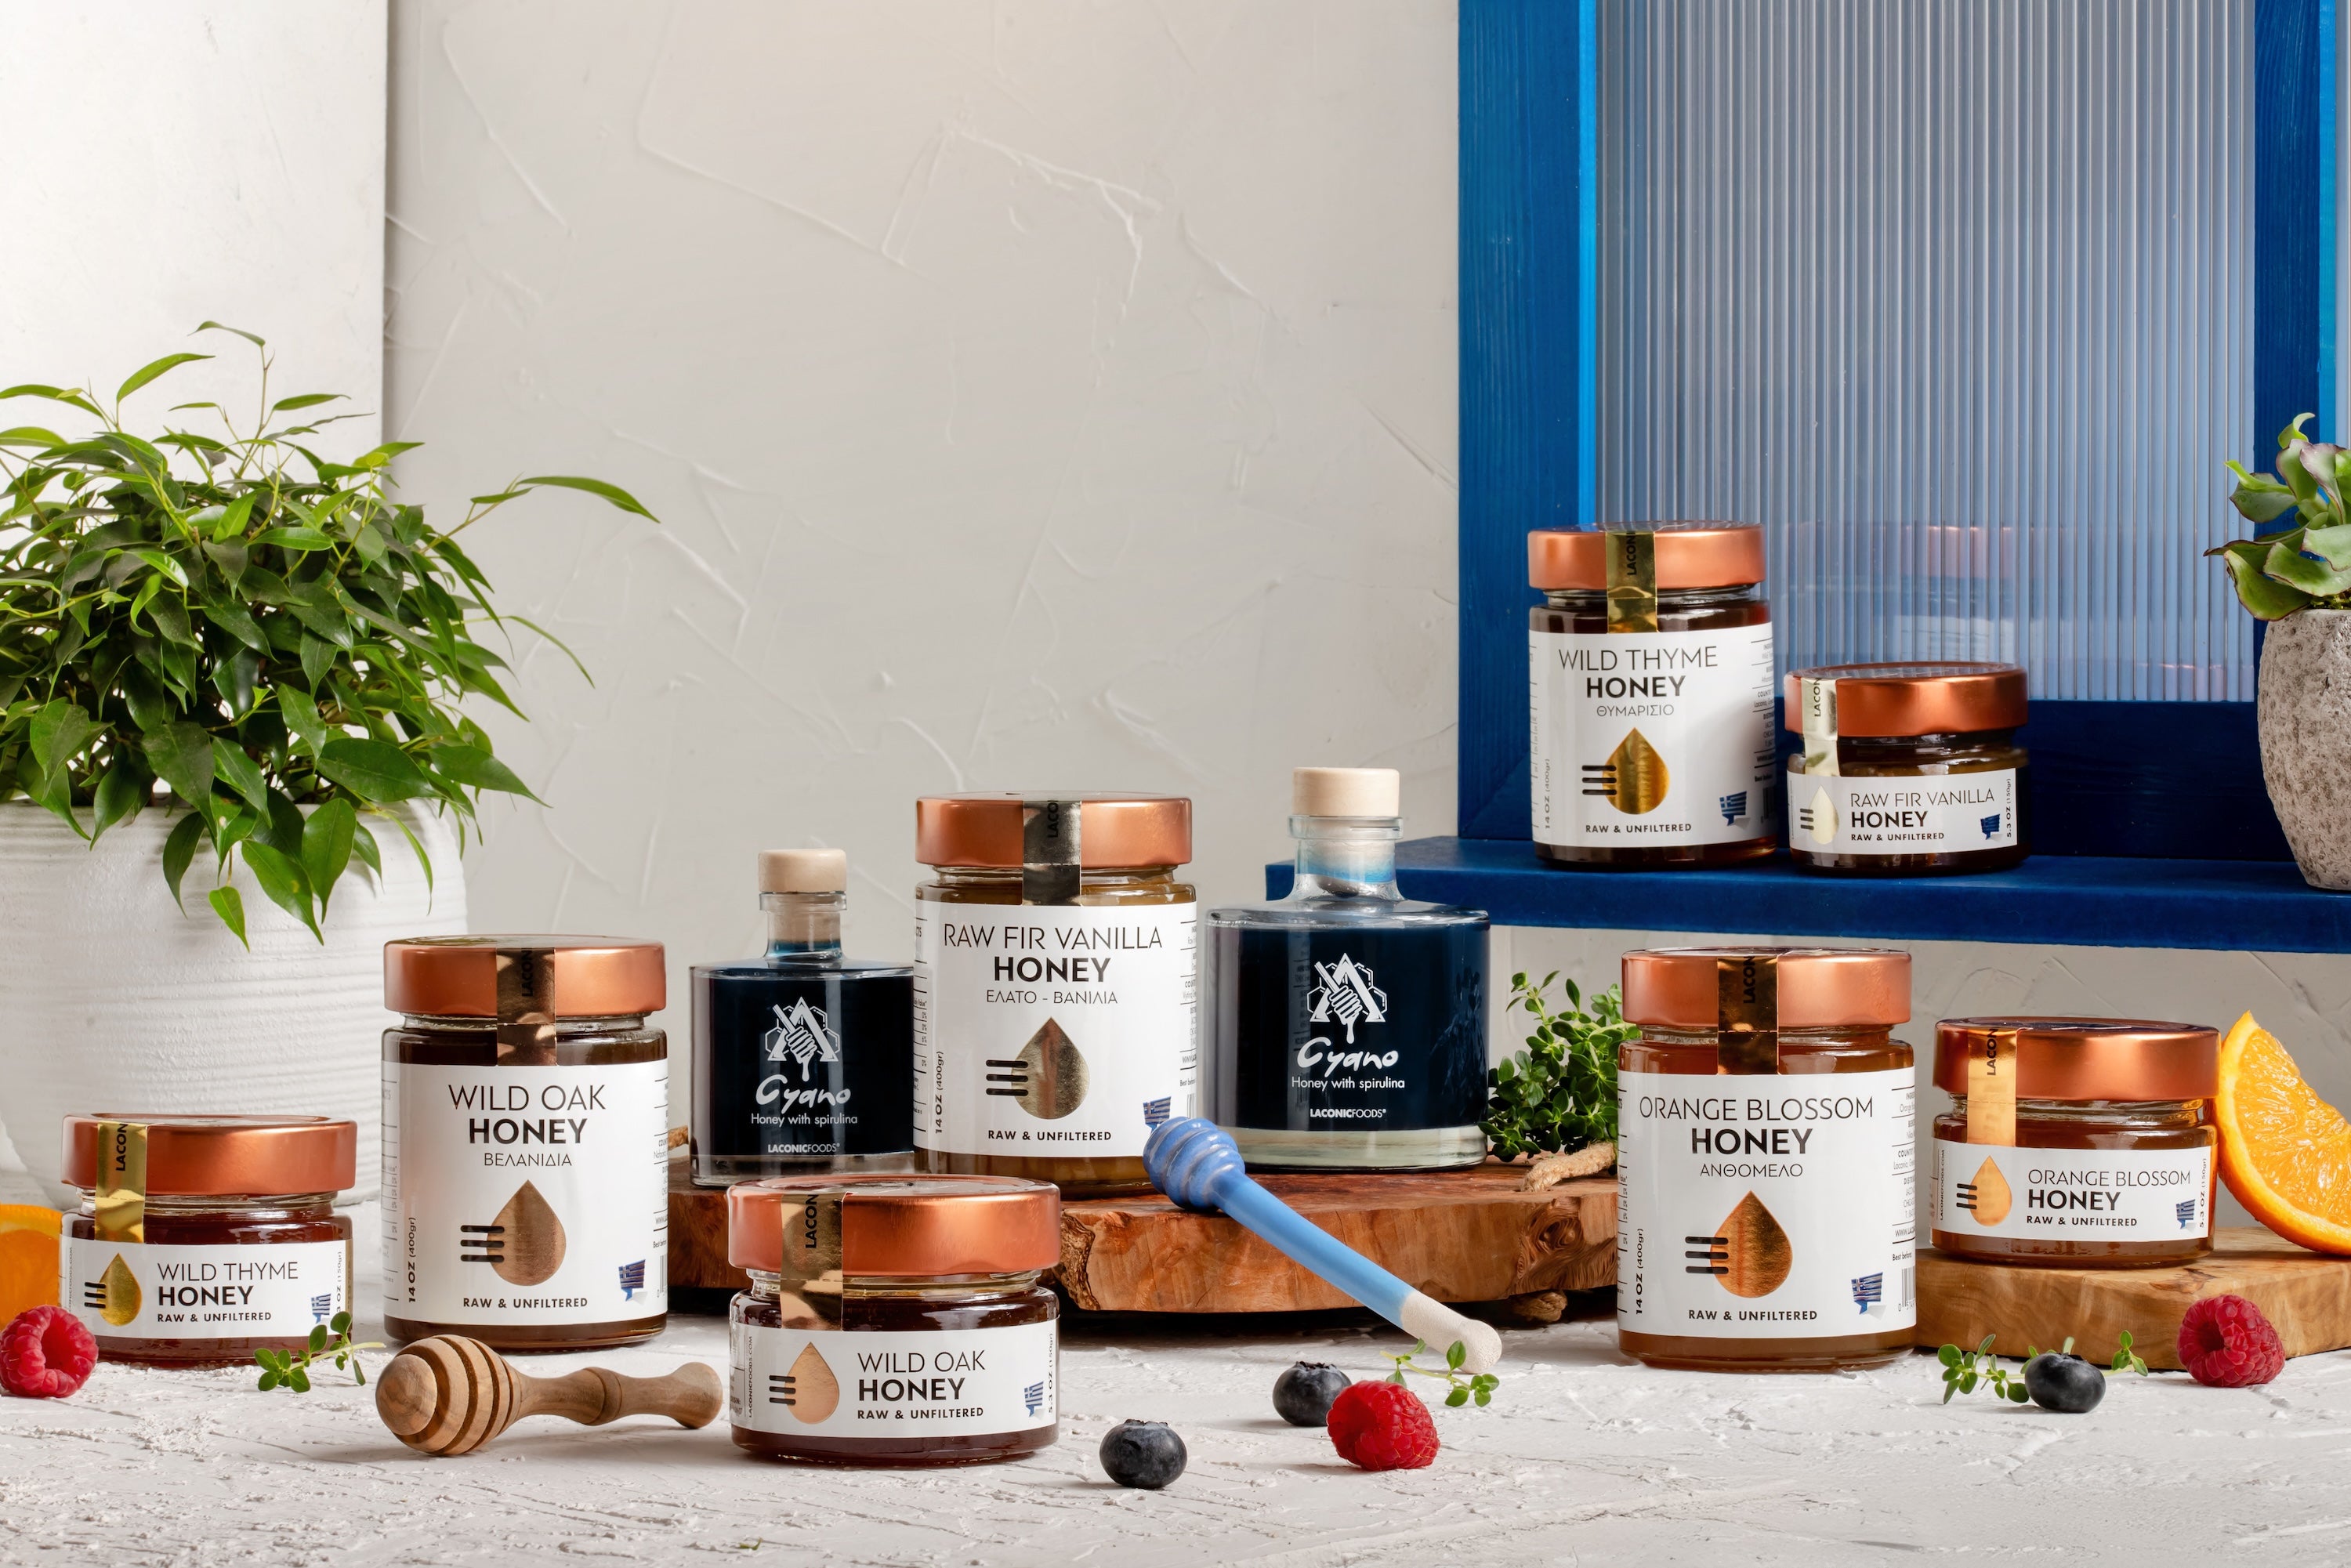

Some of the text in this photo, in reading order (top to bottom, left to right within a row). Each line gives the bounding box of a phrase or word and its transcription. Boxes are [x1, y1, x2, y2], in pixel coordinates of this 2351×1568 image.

[1559, 649, 1617, 671] WILD
[1625, 646, 1718, 670] THYME
[1586, 675, 1686, 698] HONEY
[1597, 704, 1674, 717] ΘΥΜΑΡΙΣΙΟ
[1545, 796, 1550, 813] OZ
[1851, 788, 1995, 807] RAW FIR VANILLA
[1851, 810, 1928, 827] HONEY
[2006, 806, 2011, 820] OZ
[1545, 817, 1550, 829] 14
[1585, 823, 1691, 833] RAW & UNFILTERED
[944, 923, 995, 948] RAW
[1004, 925, 1045, 950] FIR
[1055, 925, 1163, 950] VANILLA
[994, 956, 1111, 983] HONEY
[986, 990, 1038, 1005] ΕΛΑΤΟ
[1053, 991, 1118, 1005] ΒΑΝΙΛΙΑ
[1296, 1036, 1398, 1077] Cyano
[1291, 1076, 1405, 1091] Honey with spirulina
[448, 1085, 606, 1110] WILD OAK
[755, 1074, 851, 1114] Cyano
[935, 1094, 943, 1115] OZ
[1639, 1096, 1737, 1121] ORANGE
[1748, 1096, 1873, 1121] BLOSSOM
[751, 1113, 857, 1128] Honey with spirulina
[936, 1117, 942, 1133] 14
[469, 1117, 588, 1144] HONEY
[988, 1129, 1111, 1141] RAW & UNFILTERED
[116, 1124, 129, 1171] LACON
[1691, 1127, 1813, 1155] HONEY
[484, 1152, 572, 1167] ΒΕΛΑΝΙΔΙΑ
[1700, 1163, 1803, 1178] ΑΝΘΟΜΕΛΟ
[2028, 1169, 2191, 1187] ORANGE BLOSSOM
[2028, 1190, 2121, 1211] HONEY
[2201, 1191, 2204, 1207] OZ
[806, 1194, 819, 1248] LACON
[2027, 1215, 2138, 1227] RAW & UNFILTERED
[157, 1262, 298, 1282] WILD THYME
[408, 1262, 415, 1284] OZ
[1636, 1273, 1643, 1295] OZ
[158, 1285, 254, 1306] HONEY
[337, 1285, 342, 1302] OZ
[408, 1287, 415, 1302] 14
[463, 1298, 588, 1309] RAW & UNFILTERED
[1636, 1298, 1643, 1315] 14
[158, 1312, 271, 1323] RAW & UNFILTERED
[1688, 1310, 1818, 1321] RAW & UNFILTERED
[857, 1349, 986, 1374] WILD OAK
[859, 1377, 965, 1402] HONEY
[1049, 1371, 1052, 1390] OZ
[857, 1407, 984, 1420] RAW & UNFILTERED
